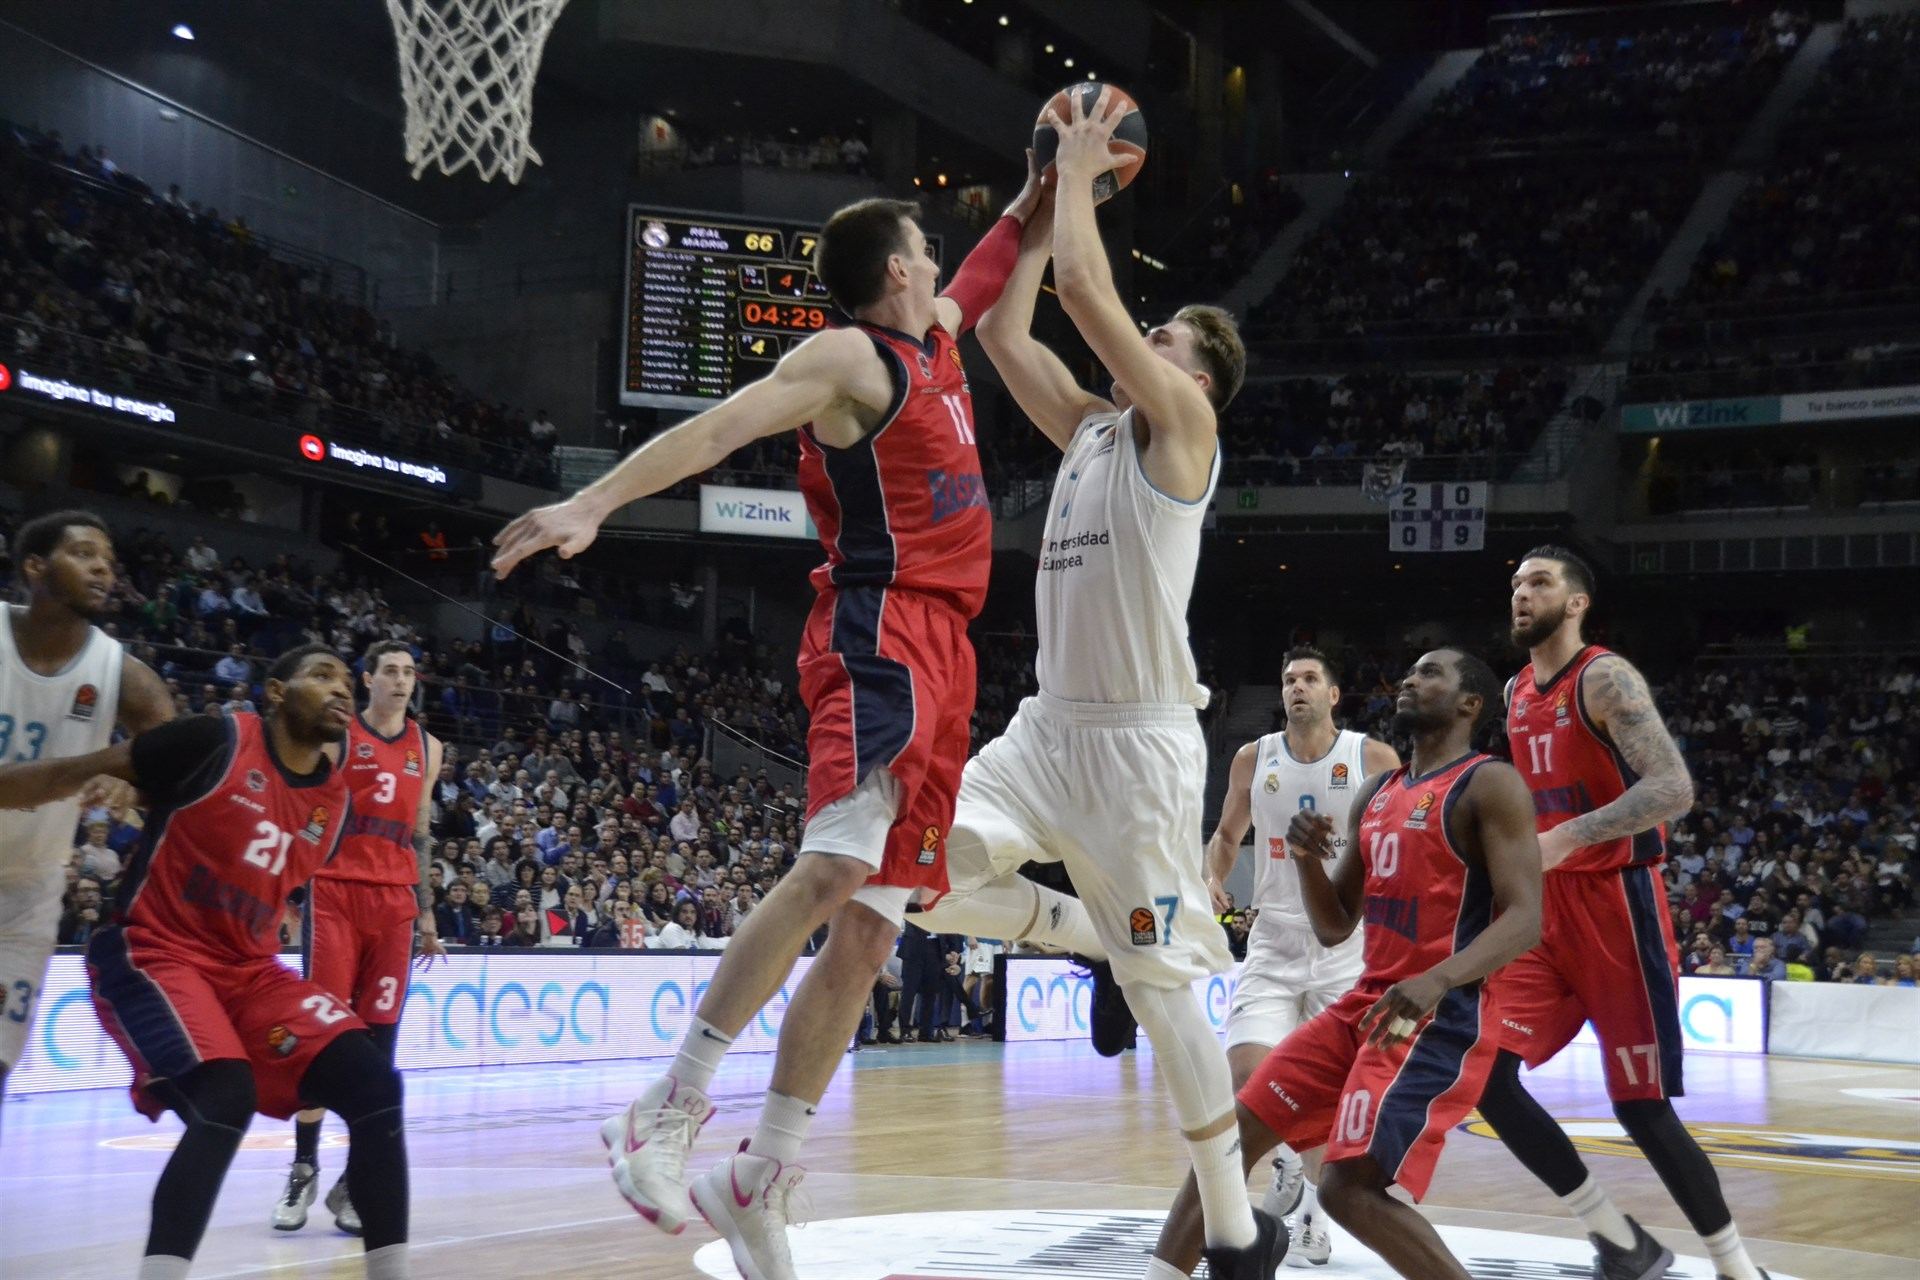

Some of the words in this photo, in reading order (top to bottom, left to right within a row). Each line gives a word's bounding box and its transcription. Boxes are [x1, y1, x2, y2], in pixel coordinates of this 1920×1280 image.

[681, 237, 728, 251] MADRID
[690, 227, 720, 239] REAL
[744, 233, 773, 252] 66
[780, 275, 793, 288] 4
[745, 303, 825, 329] 04:29
[716, 501, 792, 522] WiZink
[1528, 733, 1553, 774] 17
[373, 771, 398, 804] 3
[243, 819, 294, 876] 21
[1369, 831, 1400, 878] 10
[1154, 895, 1179, 946] 7
[375, 982, 399, 1011] 3
[1501, 1018, 1535, 1036] KELME
[1615, 1043, 1657, 1085] 17
[1267, 1080, 1301, 1112] KELME
[1335, 1089, 1371, 1143] 10
